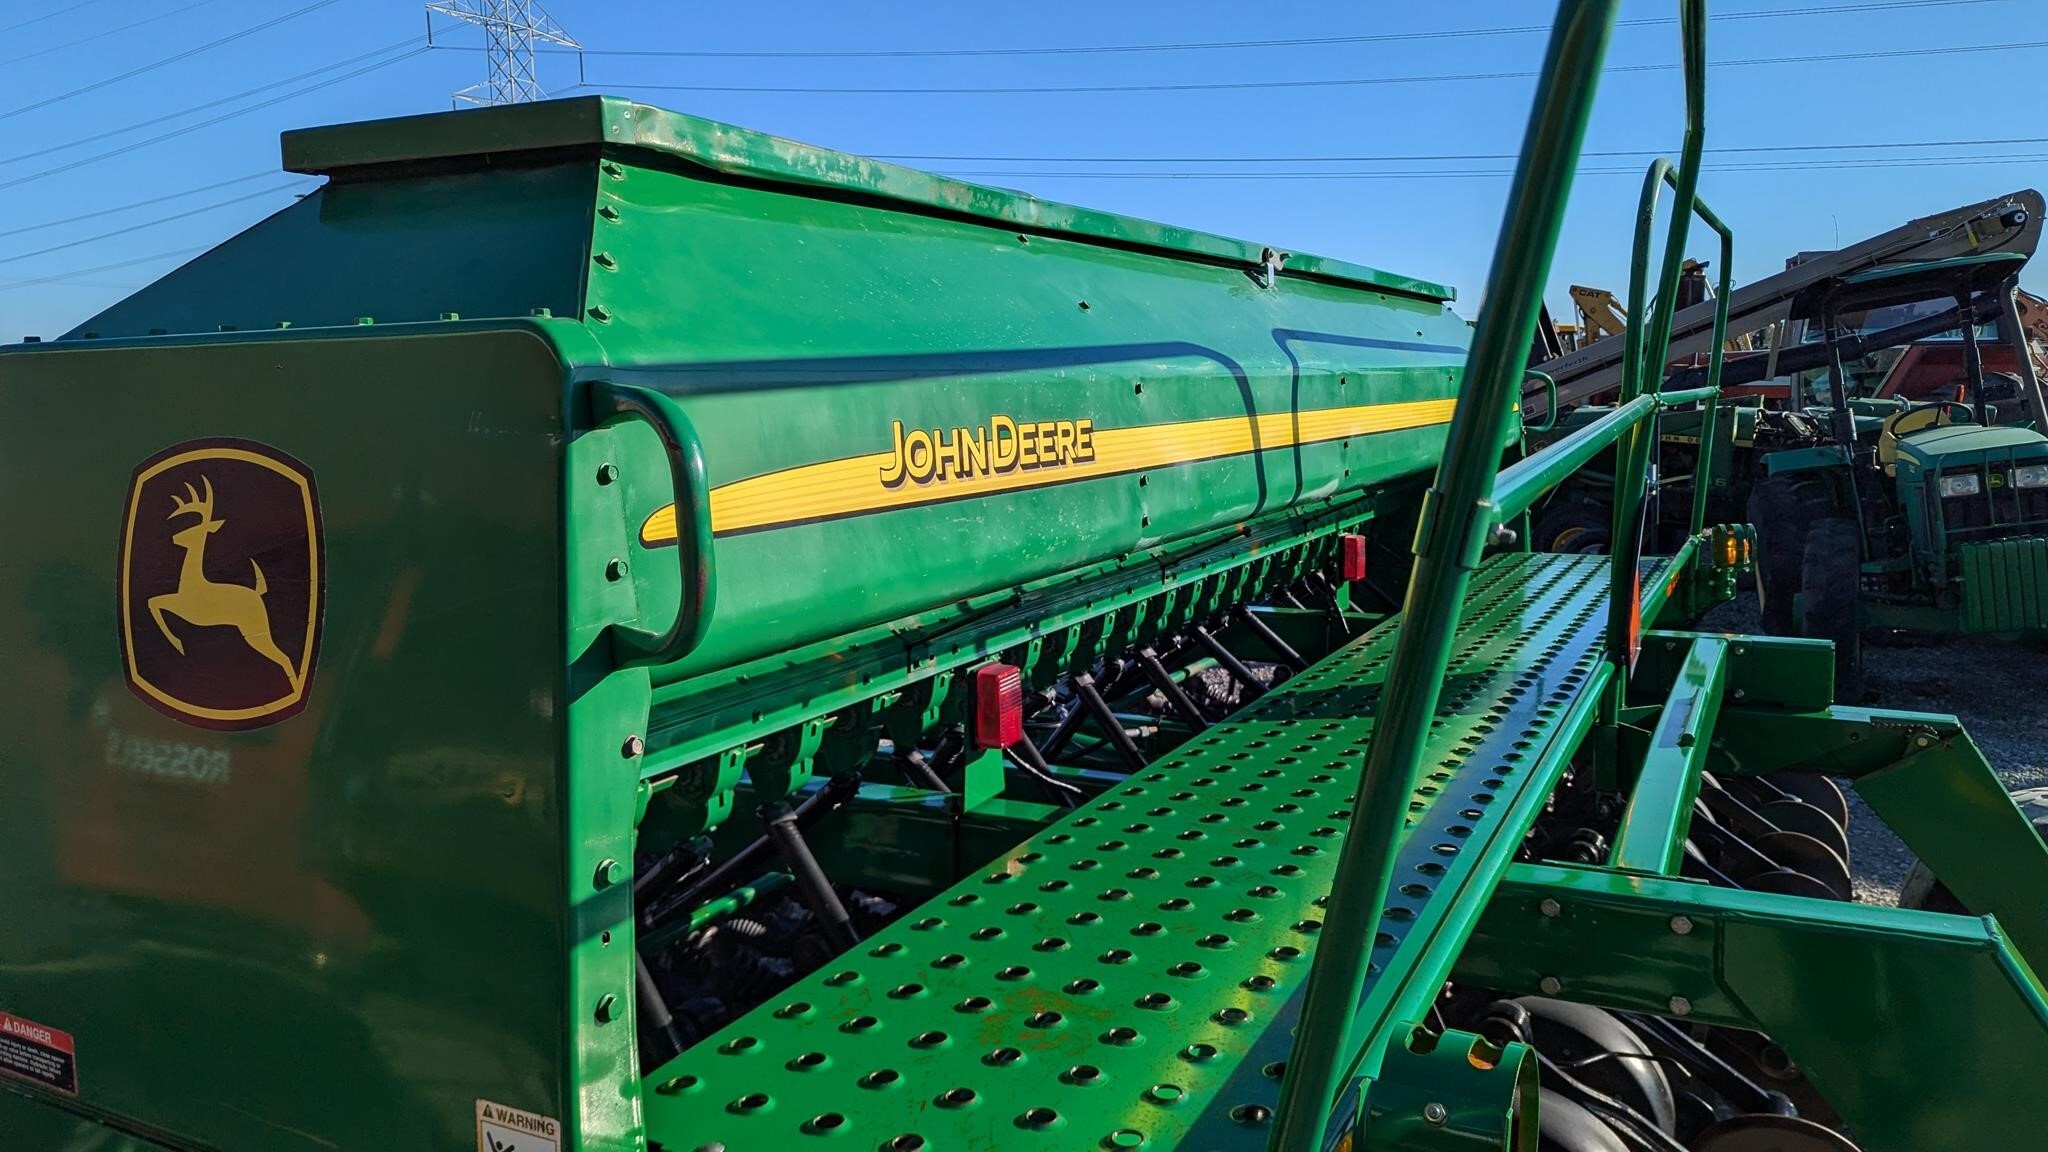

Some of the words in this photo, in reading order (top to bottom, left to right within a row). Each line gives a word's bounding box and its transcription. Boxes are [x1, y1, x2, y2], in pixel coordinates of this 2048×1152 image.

[1579, 289, 1601, 298] CAT
[880, 420, 990, 489] JOHN
[991, 415, 1094, 474] DEERE
[14, 1022, 51, 1043] DANGER
[496, 1108, 554, 1135] WARNING
